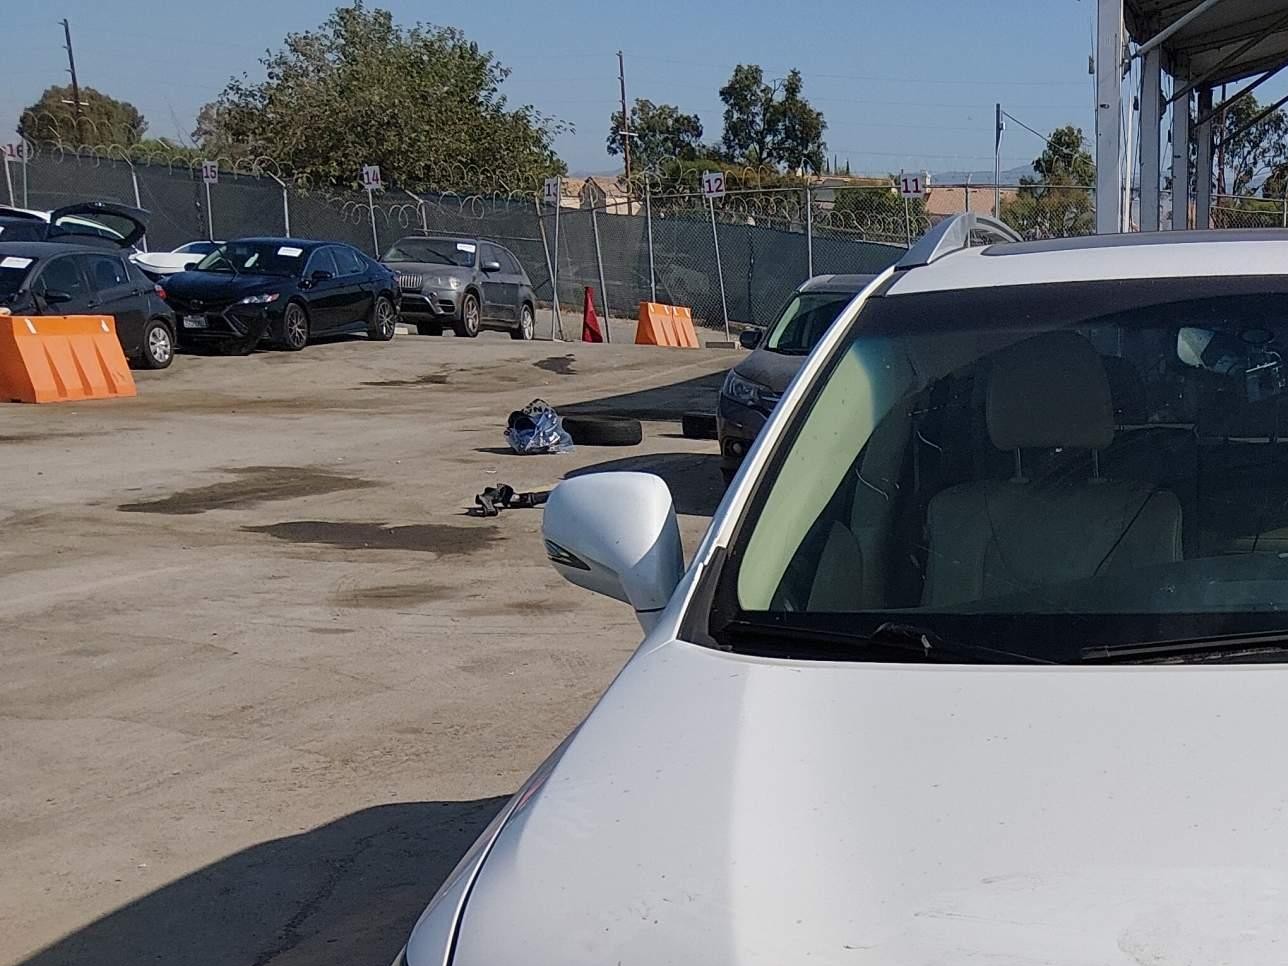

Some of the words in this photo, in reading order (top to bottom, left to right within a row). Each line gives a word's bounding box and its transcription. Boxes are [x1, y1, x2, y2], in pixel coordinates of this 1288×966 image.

[203, 165, 217, 179] 15
[365, 170, 379, 185] 14
[705, 177, 724, 193] 12
[902, 178, 922, 193] 11
